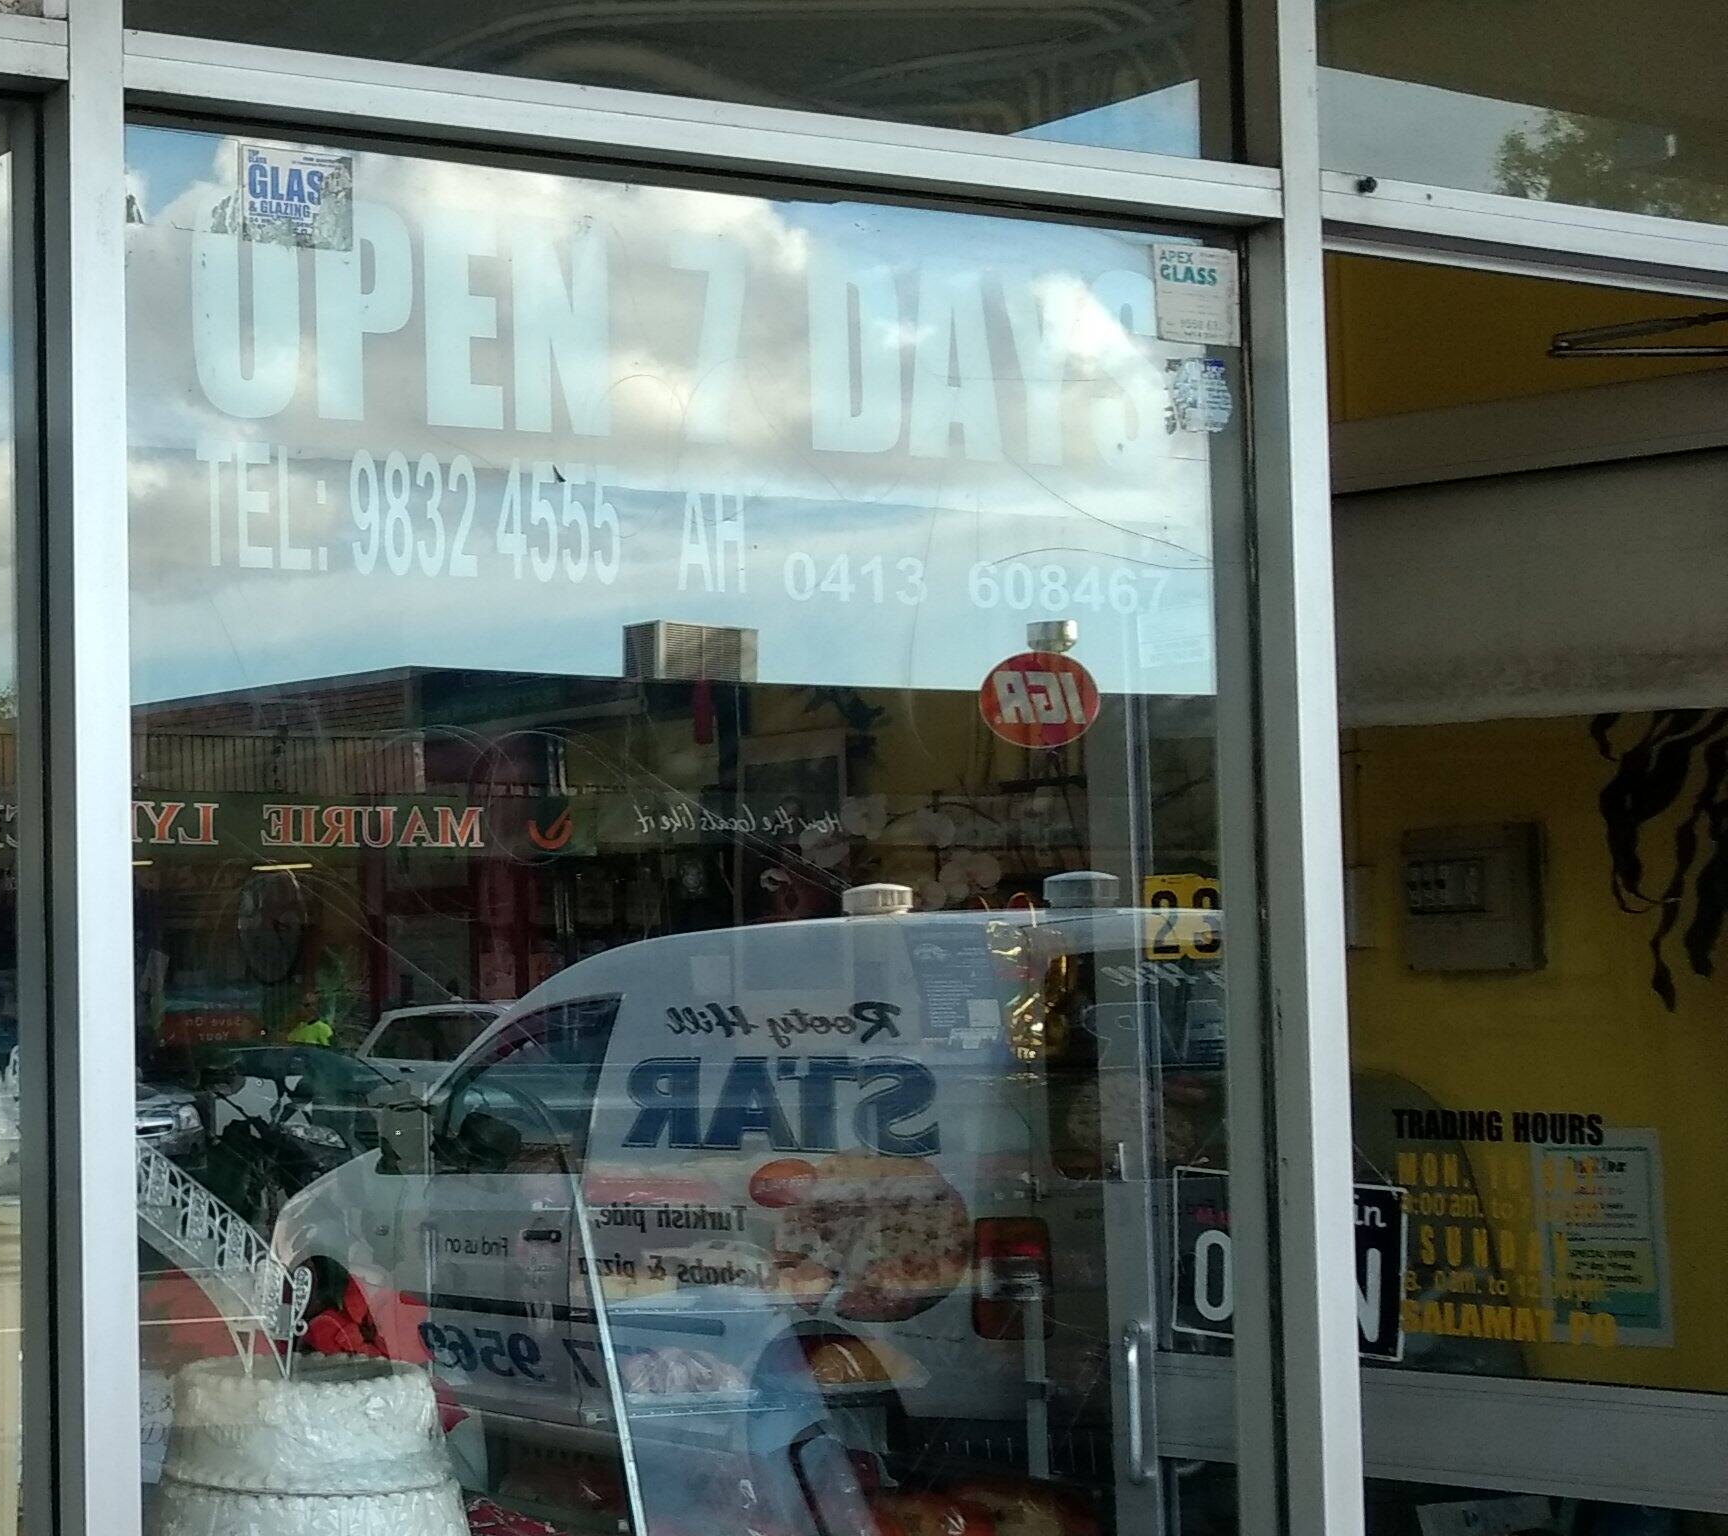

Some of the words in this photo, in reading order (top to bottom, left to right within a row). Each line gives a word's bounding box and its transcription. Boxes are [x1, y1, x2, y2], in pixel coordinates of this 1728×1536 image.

[260, 200, 311, 218] GLAZING
[1159, 249, 1194, 264] APEX
[1160, 264, 1218, 286] GLASS
[192, 197, 611, 436] OPEN
[667, 224, 747, 444] 7
[808, 249, 1170, 471] DAYS
[195, 440, 328, 571] TEL:
[349, 448, 479, 578] 9832
[496, 458, 621, 585] 4555
[676, 490, 747, 595] AH
[783, 551, 928, 607] 0413
[968, 560, 1171, 615] 608467
[1392, 1109, 1504, 1142] TRADING
[1511, 1111, 1604, 1146] HOURS
[1397, 1151, 1472, 1188] MON.
[1419, 1224, 1569, 1277] SUNDAY
[1401, 1299, 1556, 1344] SALAMAT
[1568, 1310, 1618, 1348] PO
